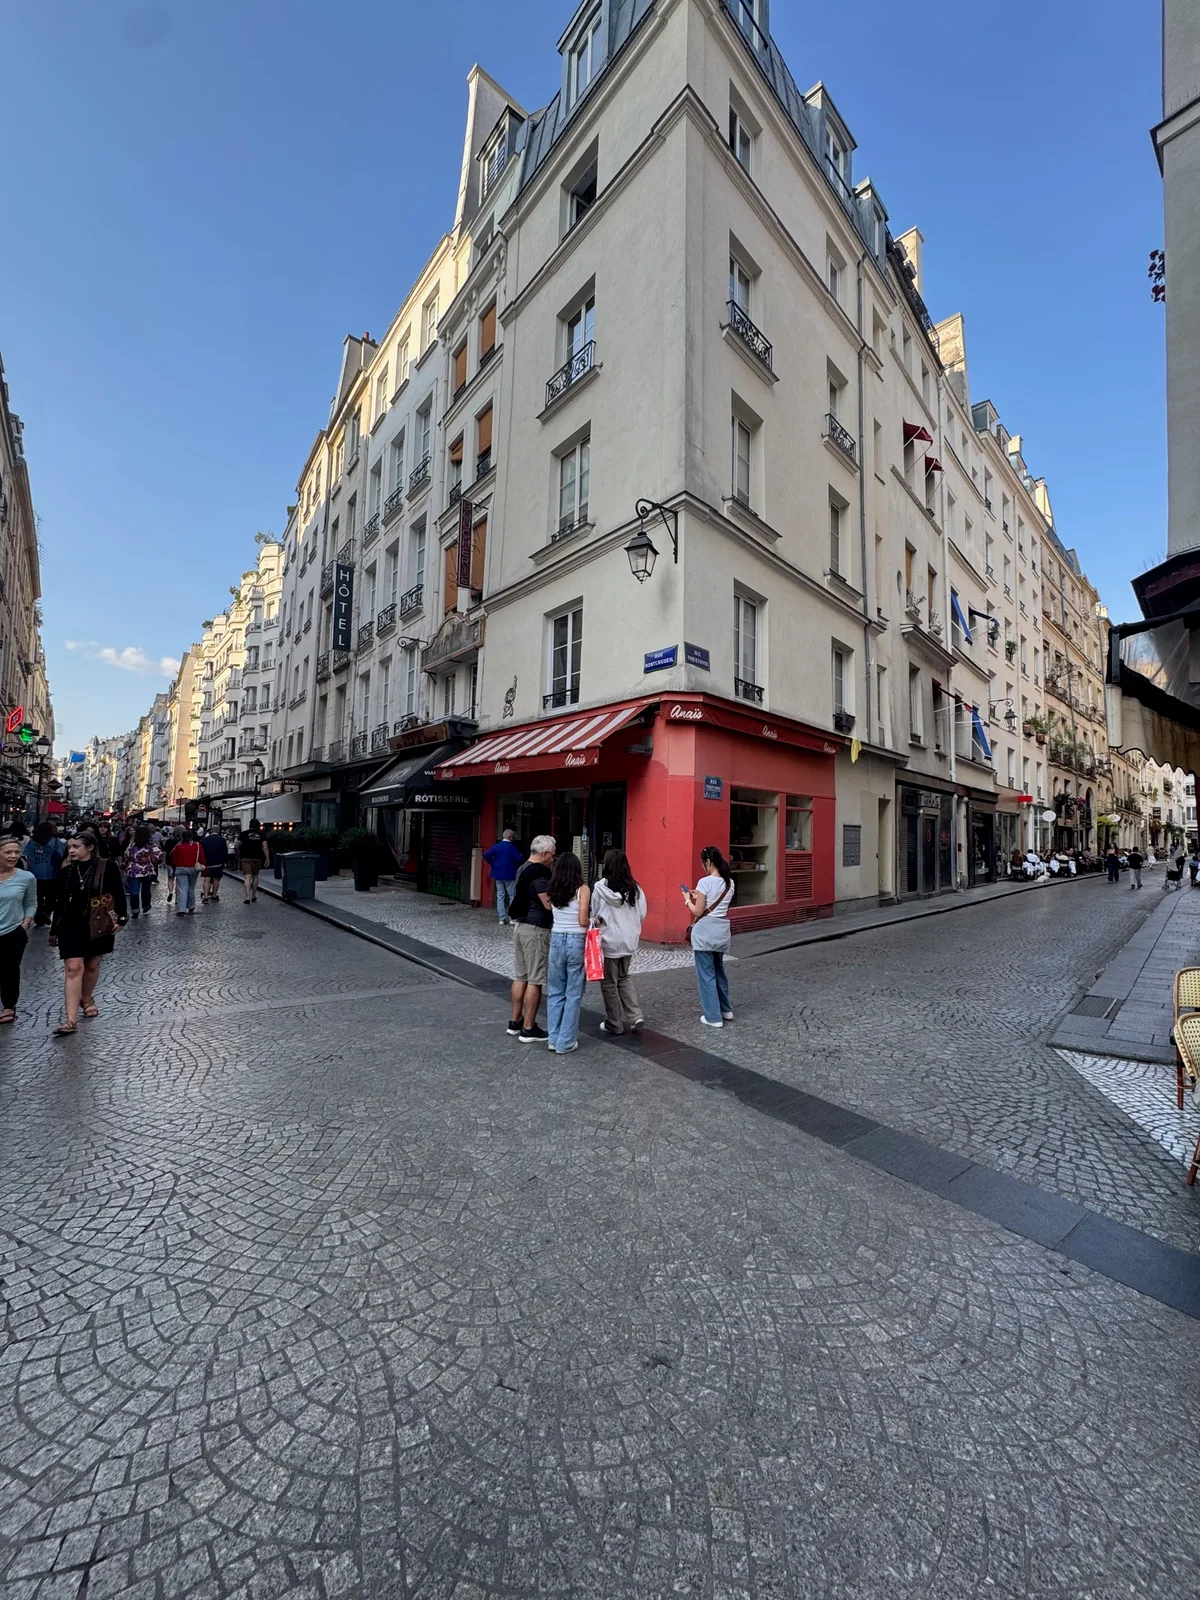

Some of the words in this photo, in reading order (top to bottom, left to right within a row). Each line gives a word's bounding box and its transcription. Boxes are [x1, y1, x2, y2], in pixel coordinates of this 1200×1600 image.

[461, 502, 471, 585] BOUCHERIE
[339, 570, 349, 646] HÔTEL
[670, 704, 704, 720] Anaïs
